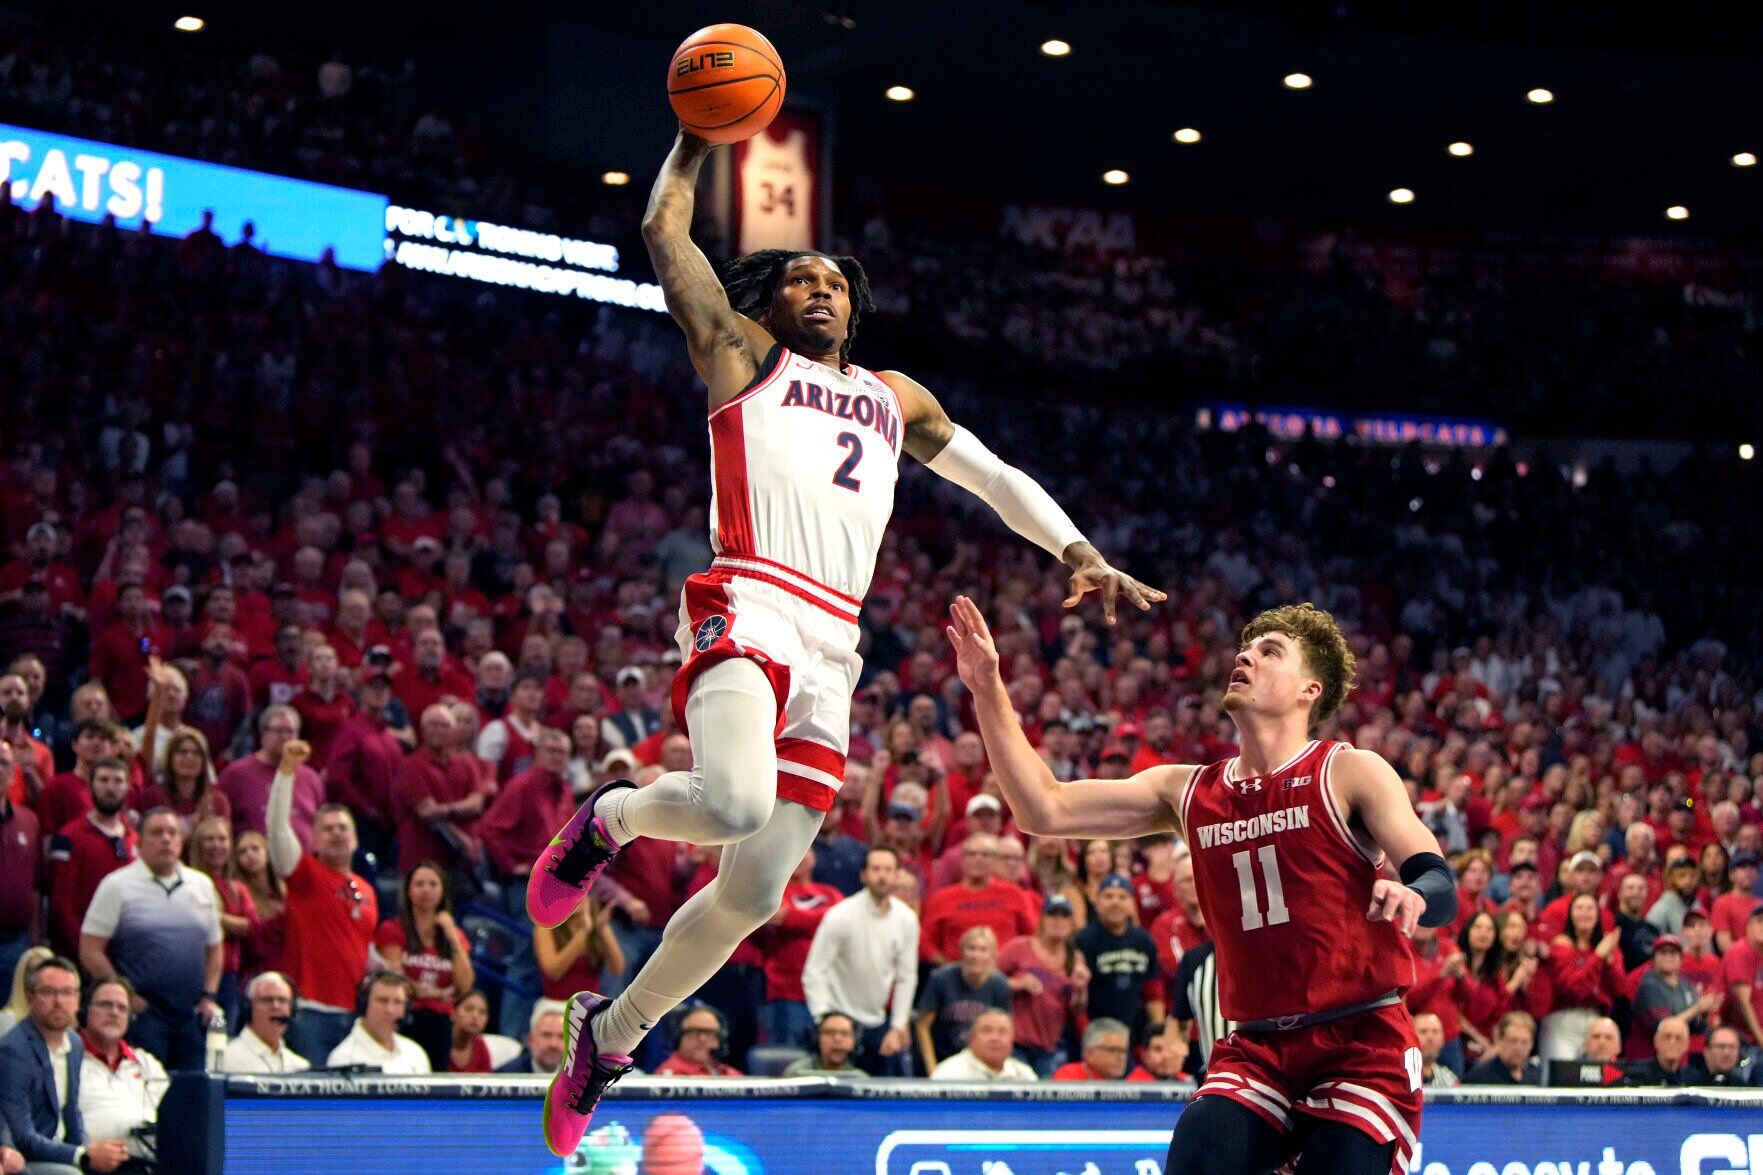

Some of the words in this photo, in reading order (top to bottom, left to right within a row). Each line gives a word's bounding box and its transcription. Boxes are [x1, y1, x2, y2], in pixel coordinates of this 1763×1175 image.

[677, 51, 735, 77] ELITE
[0, 140, 164, 222] CATS!
[760, 181, 795, 217] 34
[781, 379, 898, 457] ARIZONA
[832, 431, 864, 493] 2
[1197, 805, 1310, 849] WISCONSIN
[1232, 845, 1290, 931] 11
[564, 999, 588, 1078] NIKE
